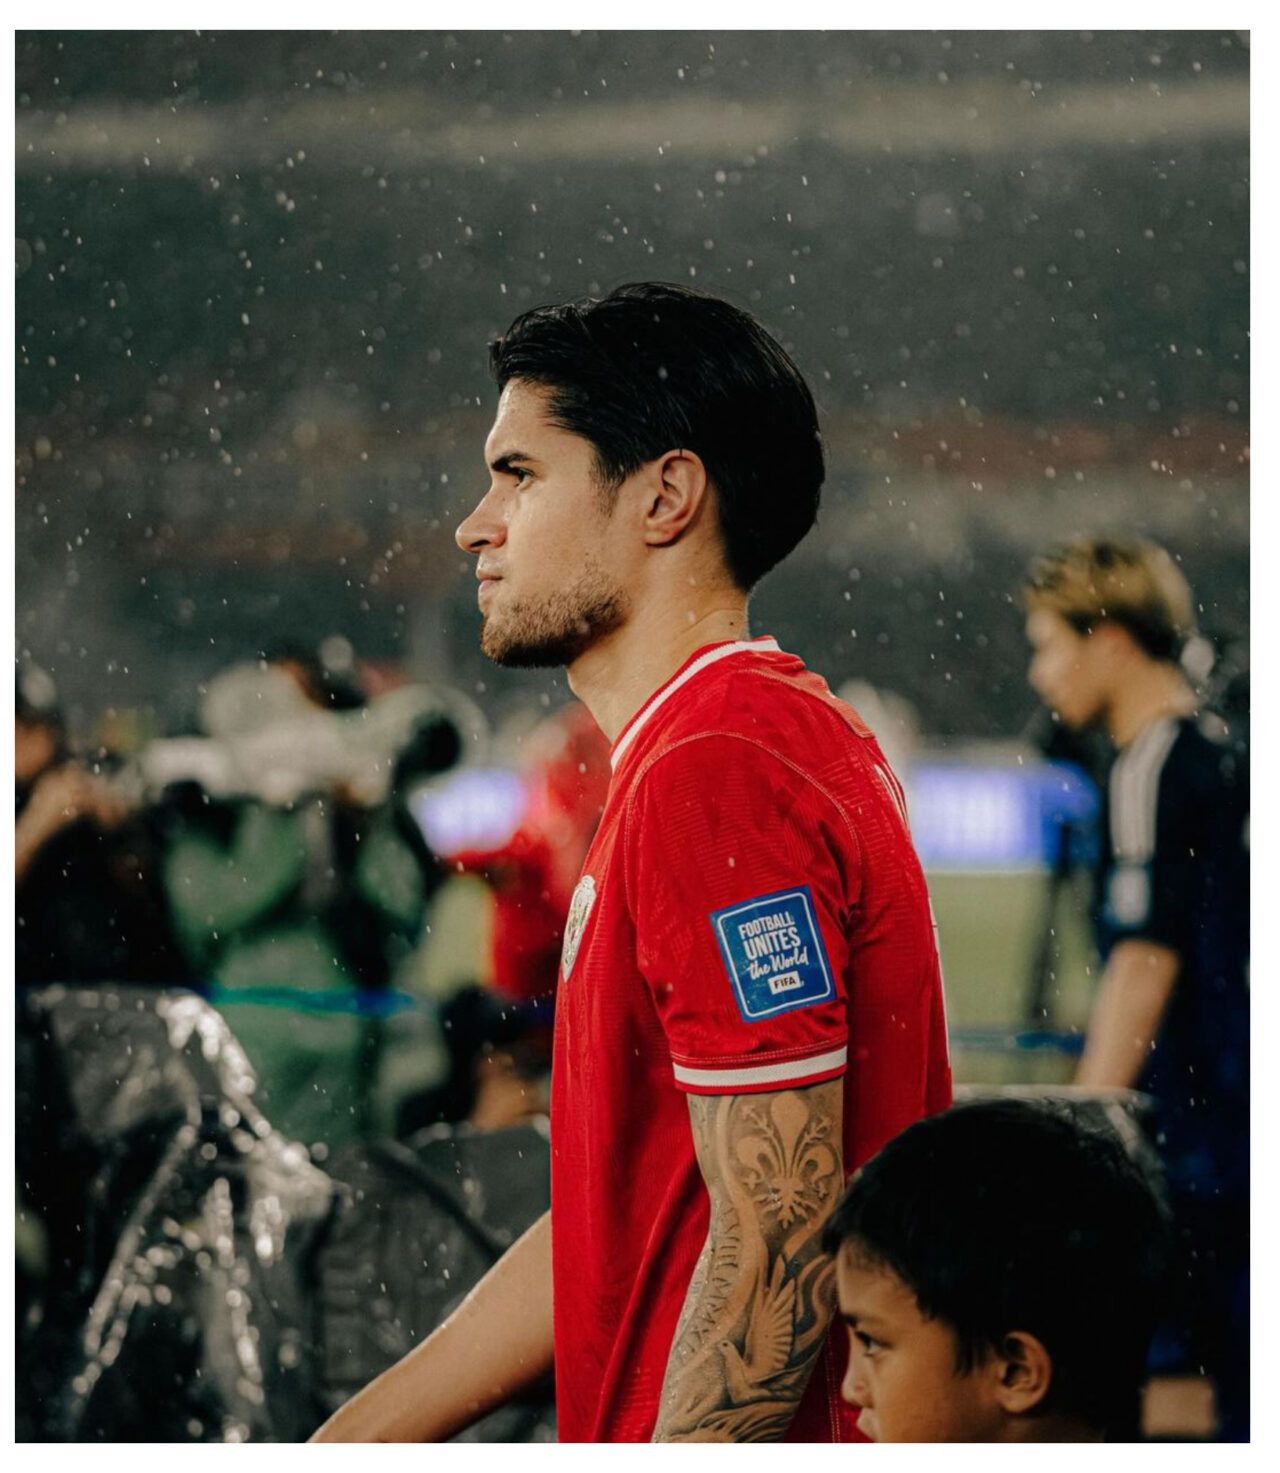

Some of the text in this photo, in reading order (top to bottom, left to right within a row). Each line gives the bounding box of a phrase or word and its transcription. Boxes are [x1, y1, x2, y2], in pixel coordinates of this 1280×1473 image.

[738, 912, 795, 939] FOOTBALL
[743, 927, 801, 960] UNITES
[745, 946, 809, 980] the World
[774, 976, 797, 989] FIFA
